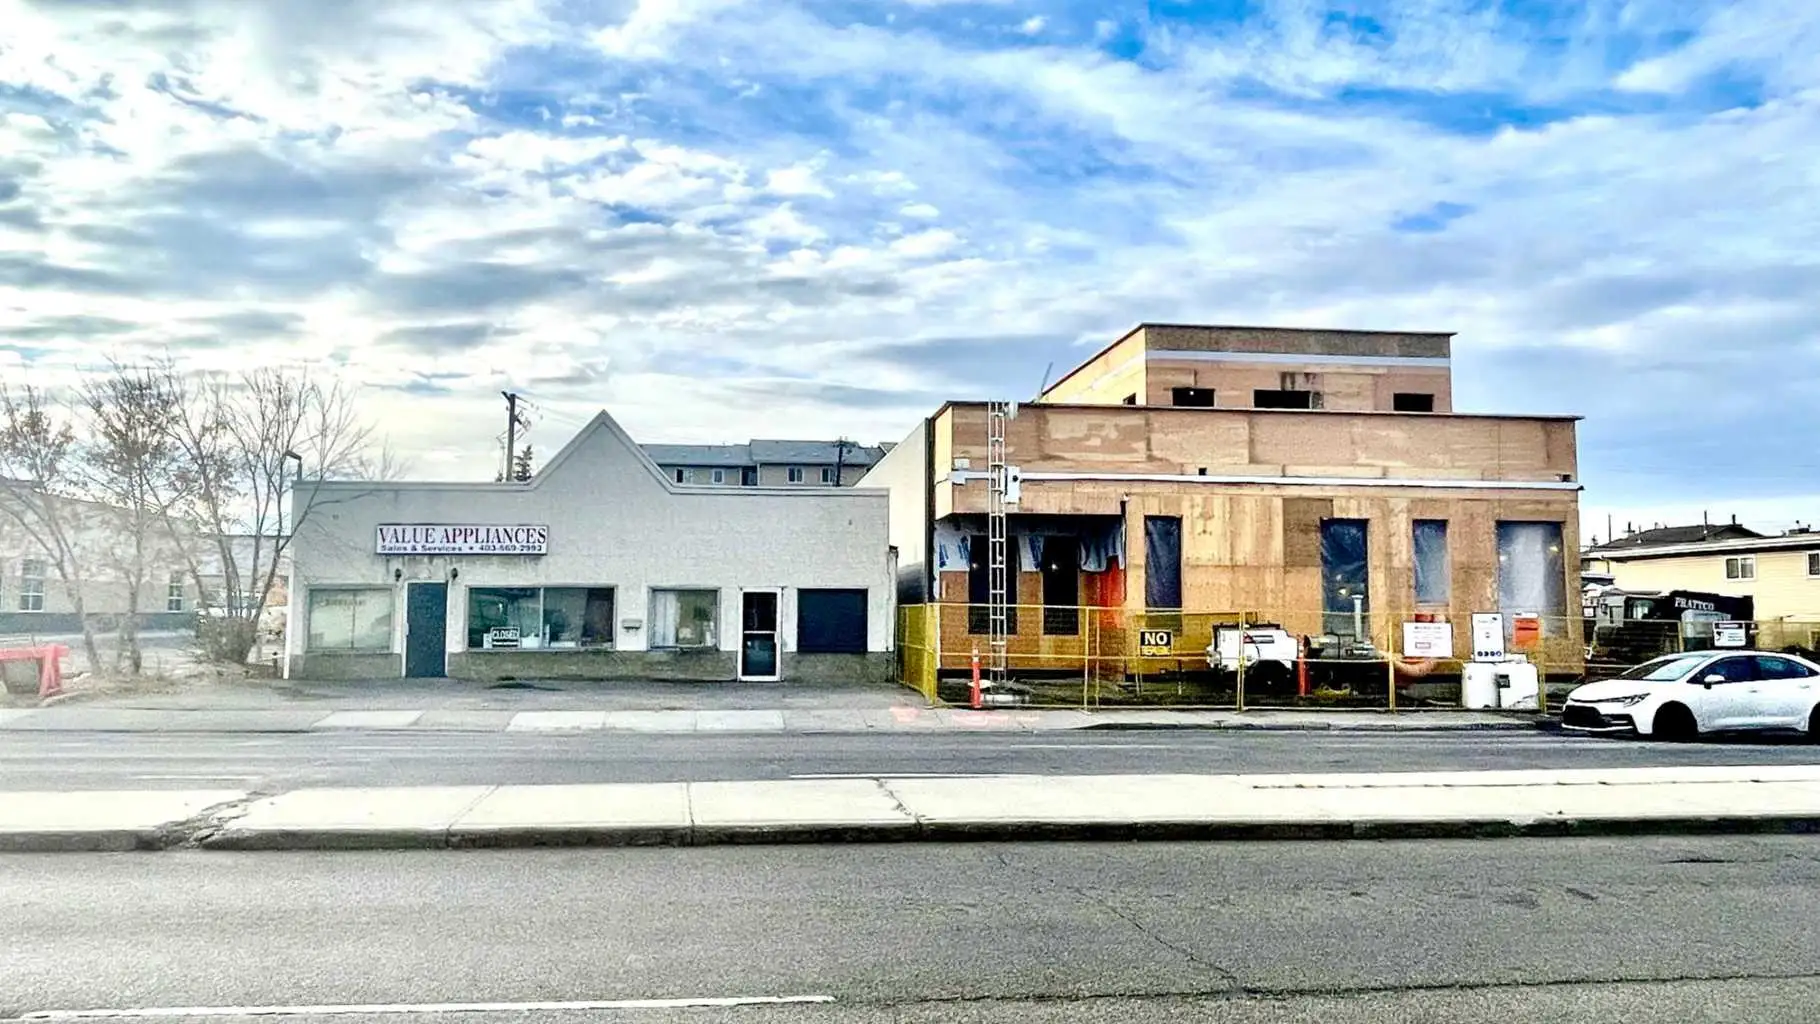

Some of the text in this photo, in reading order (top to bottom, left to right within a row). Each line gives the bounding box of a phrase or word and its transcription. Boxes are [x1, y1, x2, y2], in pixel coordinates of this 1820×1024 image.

[378, 527, 546, 545] VALUE APPLIANCES
[492, 630, 519, 640] CLOSED
[1144, 632, 1168, 645] NO
